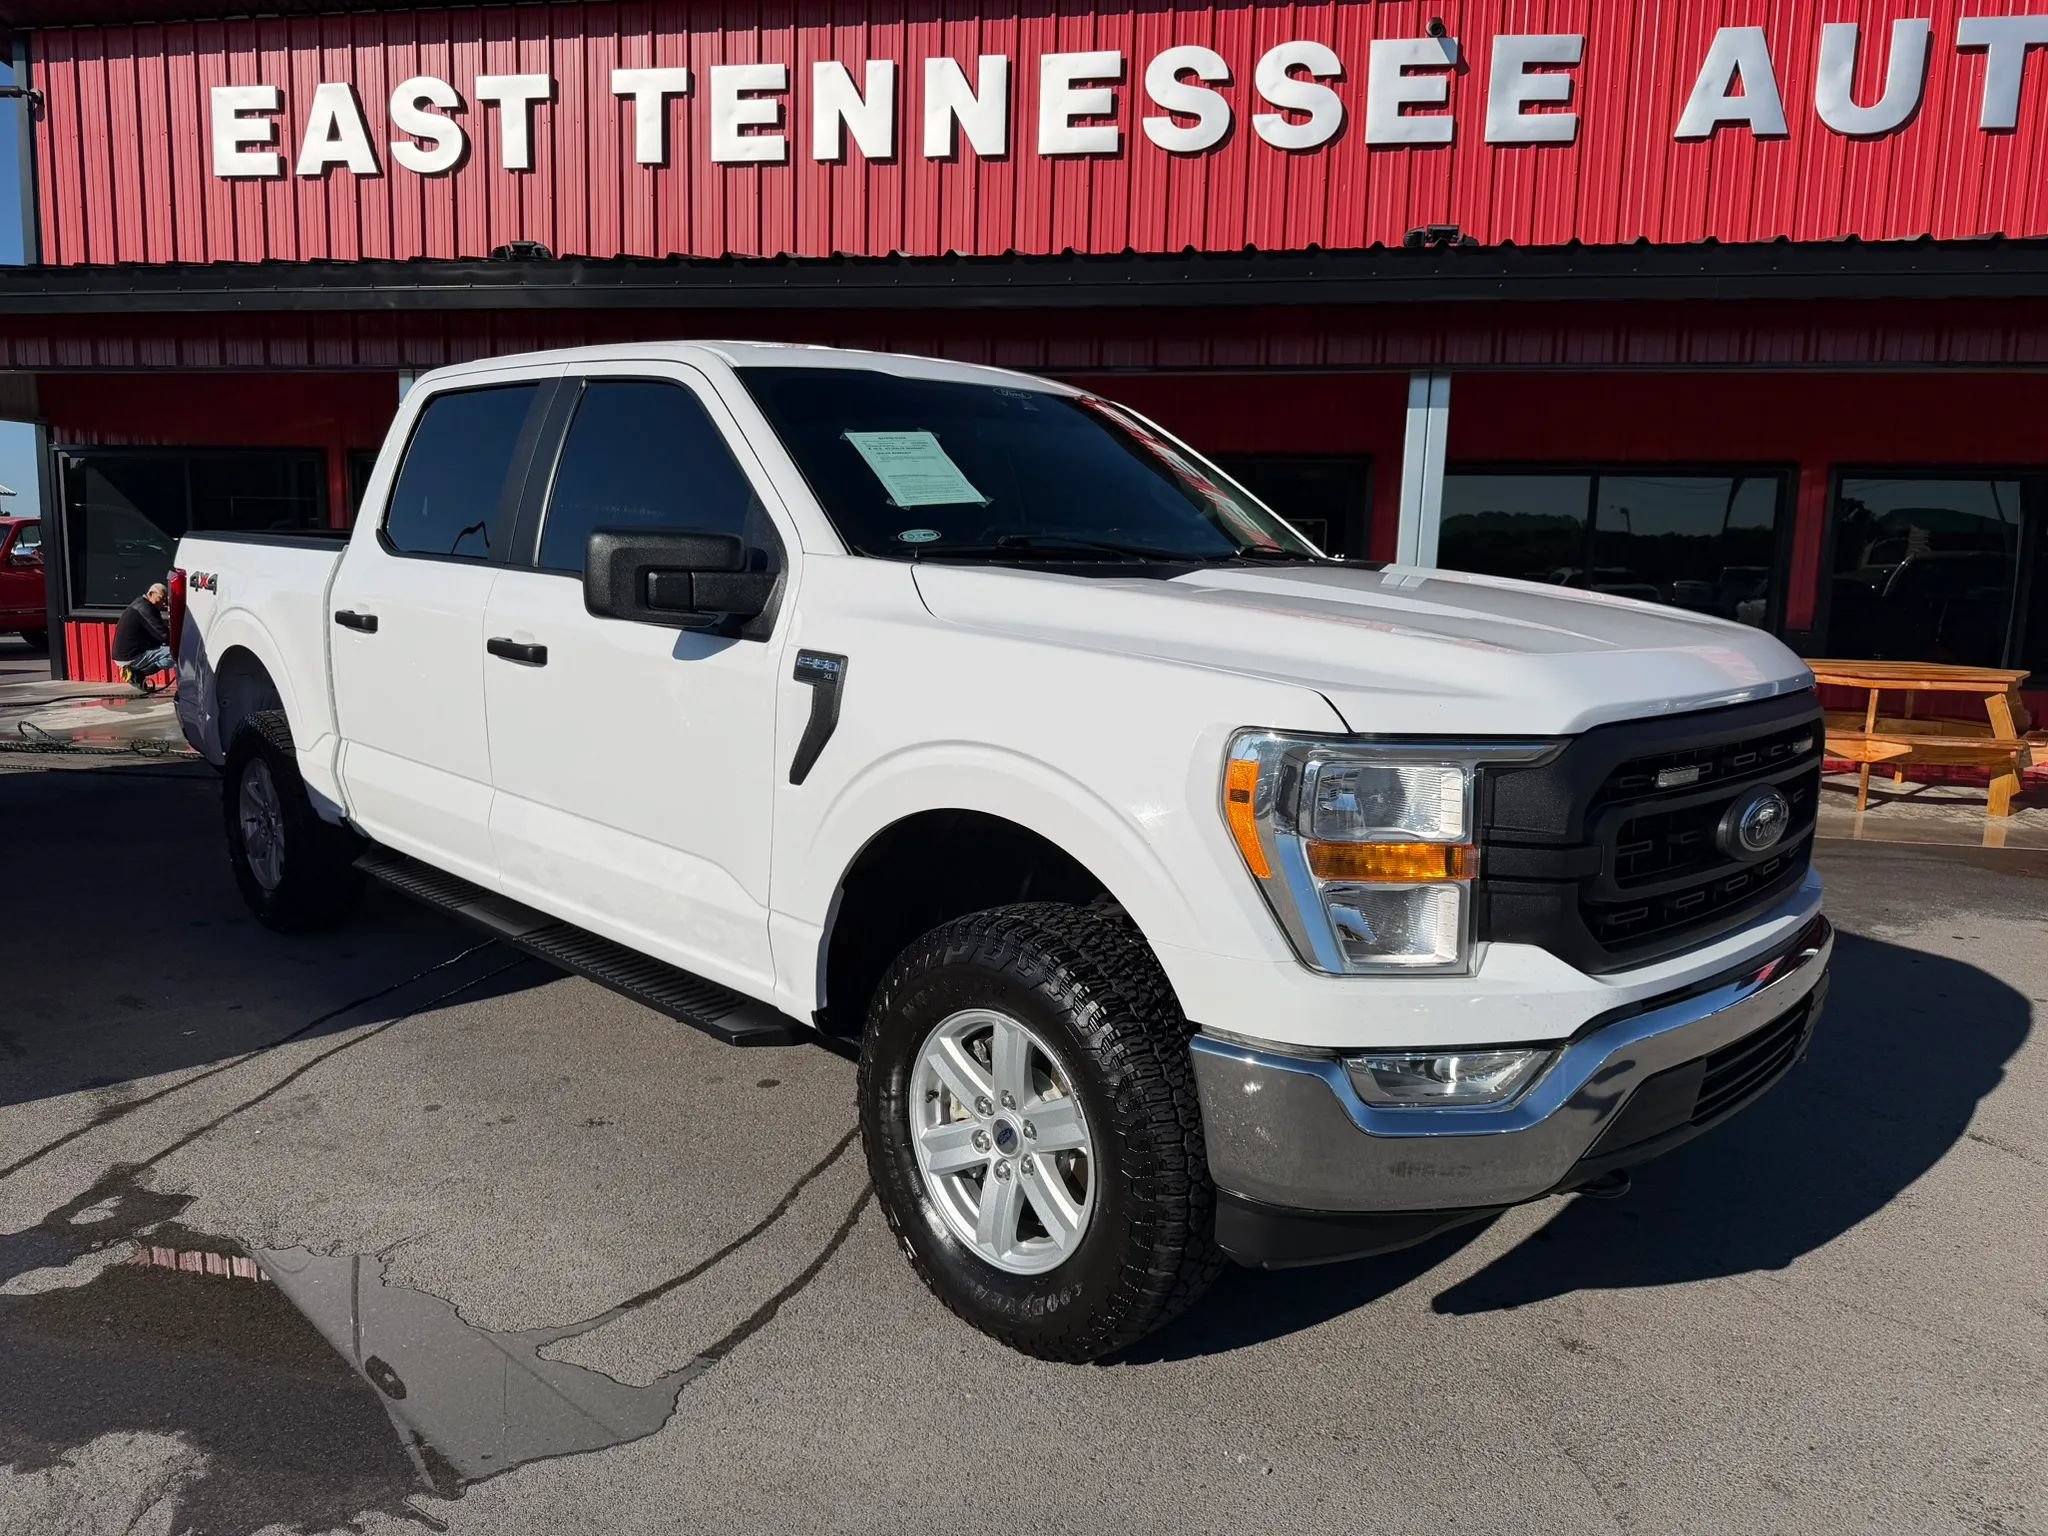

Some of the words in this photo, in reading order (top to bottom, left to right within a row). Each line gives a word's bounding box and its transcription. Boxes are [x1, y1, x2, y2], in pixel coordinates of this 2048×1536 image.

[211, 74, 551, 178] EAST
[611, 34, 1584, 165] TENNESSEE
[1674, 15, 2048, 138] AUT
